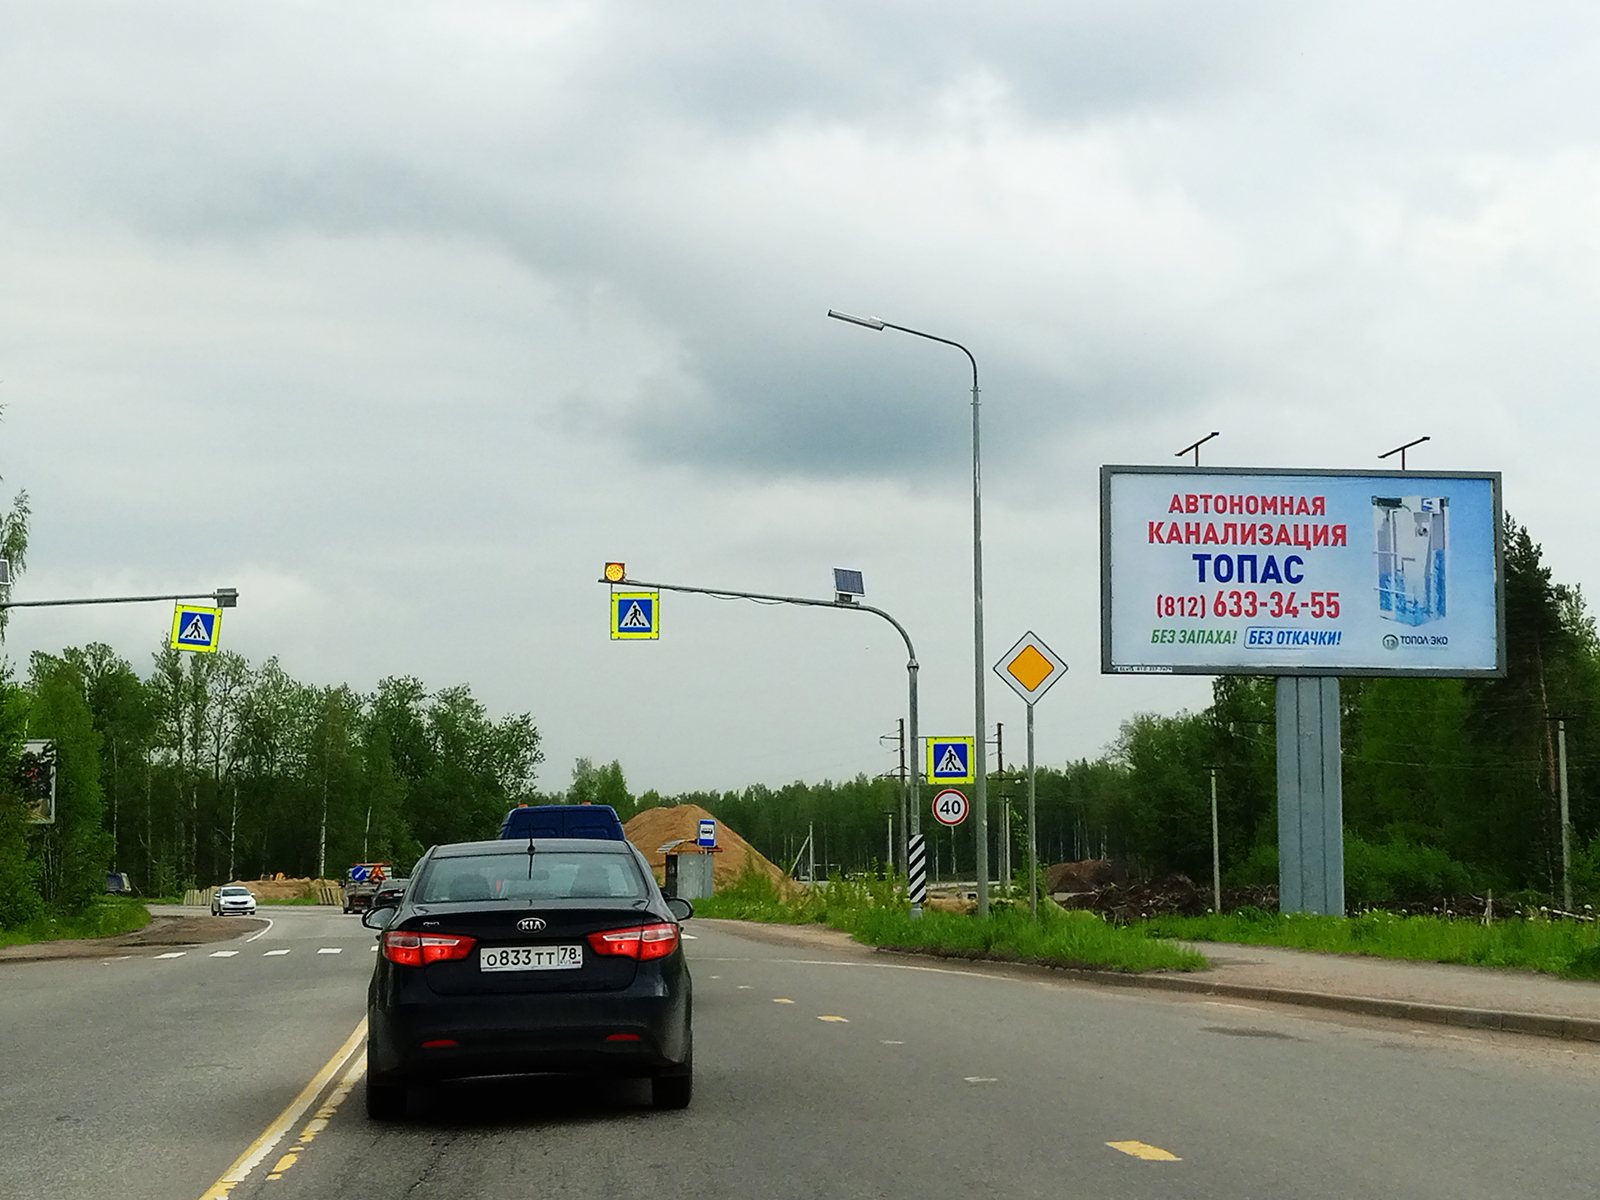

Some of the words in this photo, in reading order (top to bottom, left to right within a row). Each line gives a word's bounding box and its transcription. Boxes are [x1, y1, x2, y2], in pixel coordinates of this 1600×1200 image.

[1168, 494, 1326, 516] АВТОНОМНАЯ
[1148, 521, 1347, 550] КАНАЛИЗАЦИЯ
[1192, 553, 1304, 584] ТОПАС
[1156, 594, 1206, 619] (812)
[1213, 590, 1340, 619] 633-34-55
[1151, 629, 1175, 644] БЕЗ
[1178, 629, 1238, 645] ЗАПАХА!
[1249, 630, 1273, 645] БЕЗ
[1276, 631, 1342, 646] ОТКАЧКИ!
[939, 800, 961, 815] 40
[521, 921, 541, 930] KIA
[560, 947, 577, 961] 78
